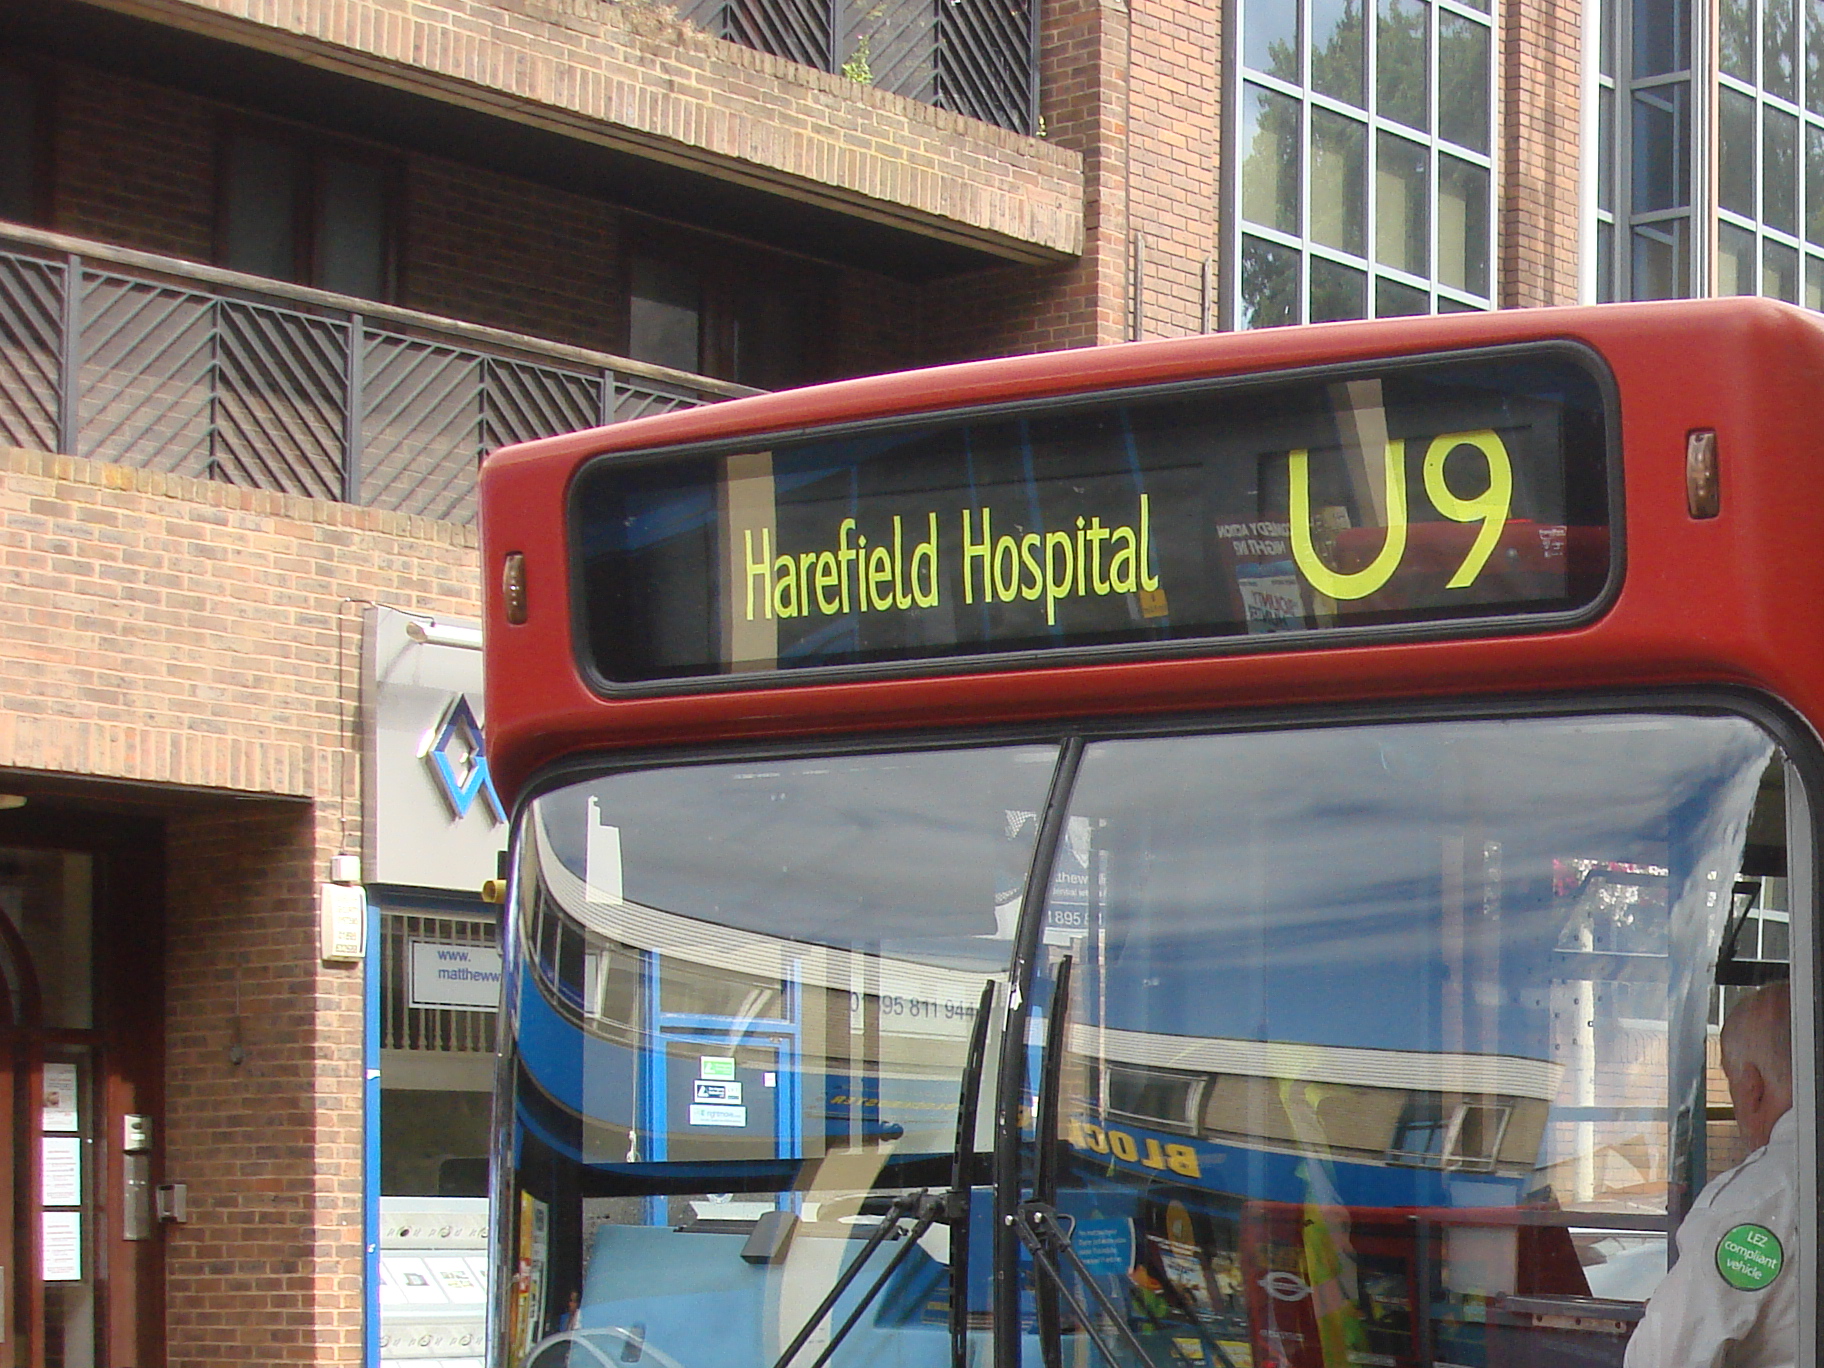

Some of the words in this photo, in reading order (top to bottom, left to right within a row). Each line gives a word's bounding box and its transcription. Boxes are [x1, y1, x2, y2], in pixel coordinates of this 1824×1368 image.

[1289, 430, 1512, 599] U9
[745, 513, 938, 621] Harefield
[962, 493, 1158, 625] Hospital
[437, 950, 471, 962] www.
[910, 997, 937, 1018] 811
[1747, 1230, 1768, 1247] LEZ
[1725, 1241, 1778, 1269] compliant
[1726, 1258, 1762, 1280] vehicle
